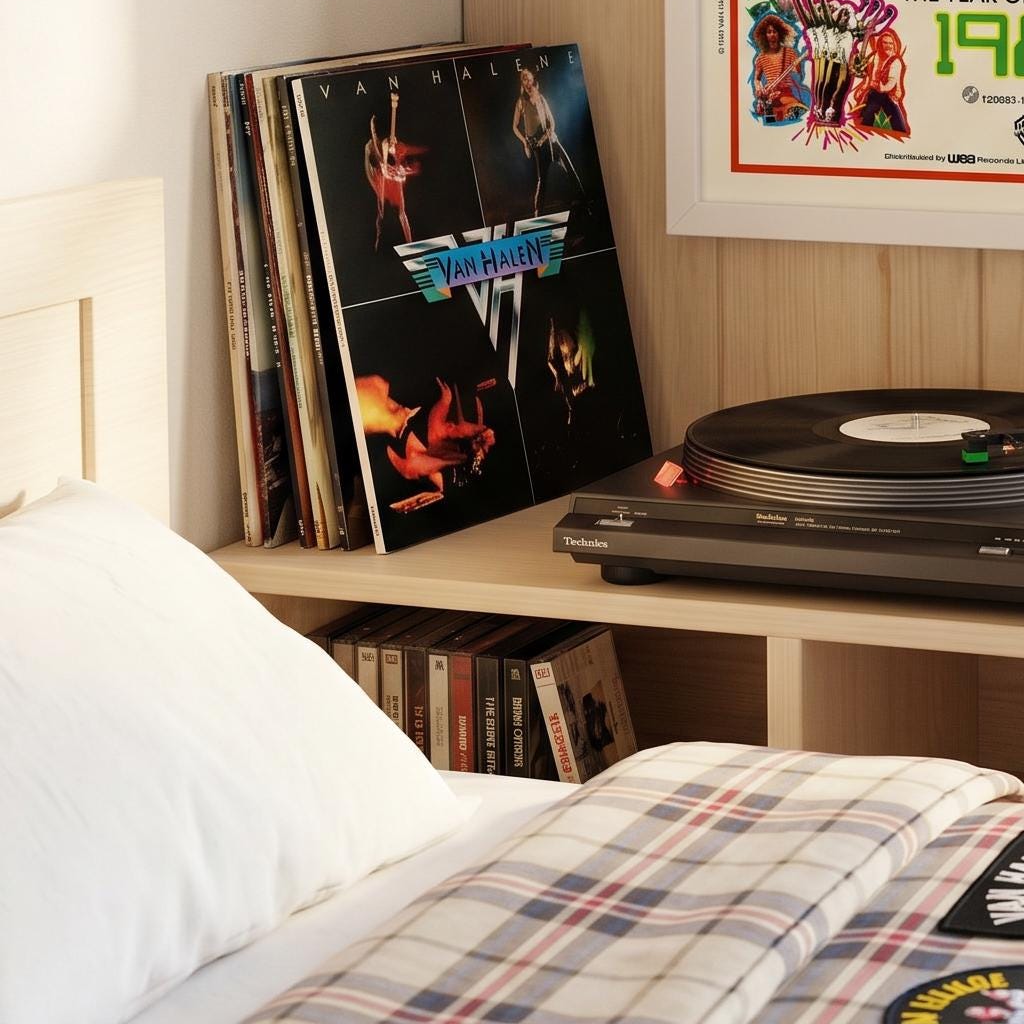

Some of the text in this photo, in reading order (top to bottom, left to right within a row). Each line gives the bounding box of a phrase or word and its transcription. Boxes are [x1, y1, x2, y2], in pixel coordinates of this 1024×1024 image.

[948, 154, 976, 164] wea
[436, 236, 544, 286] VAN HALEN
